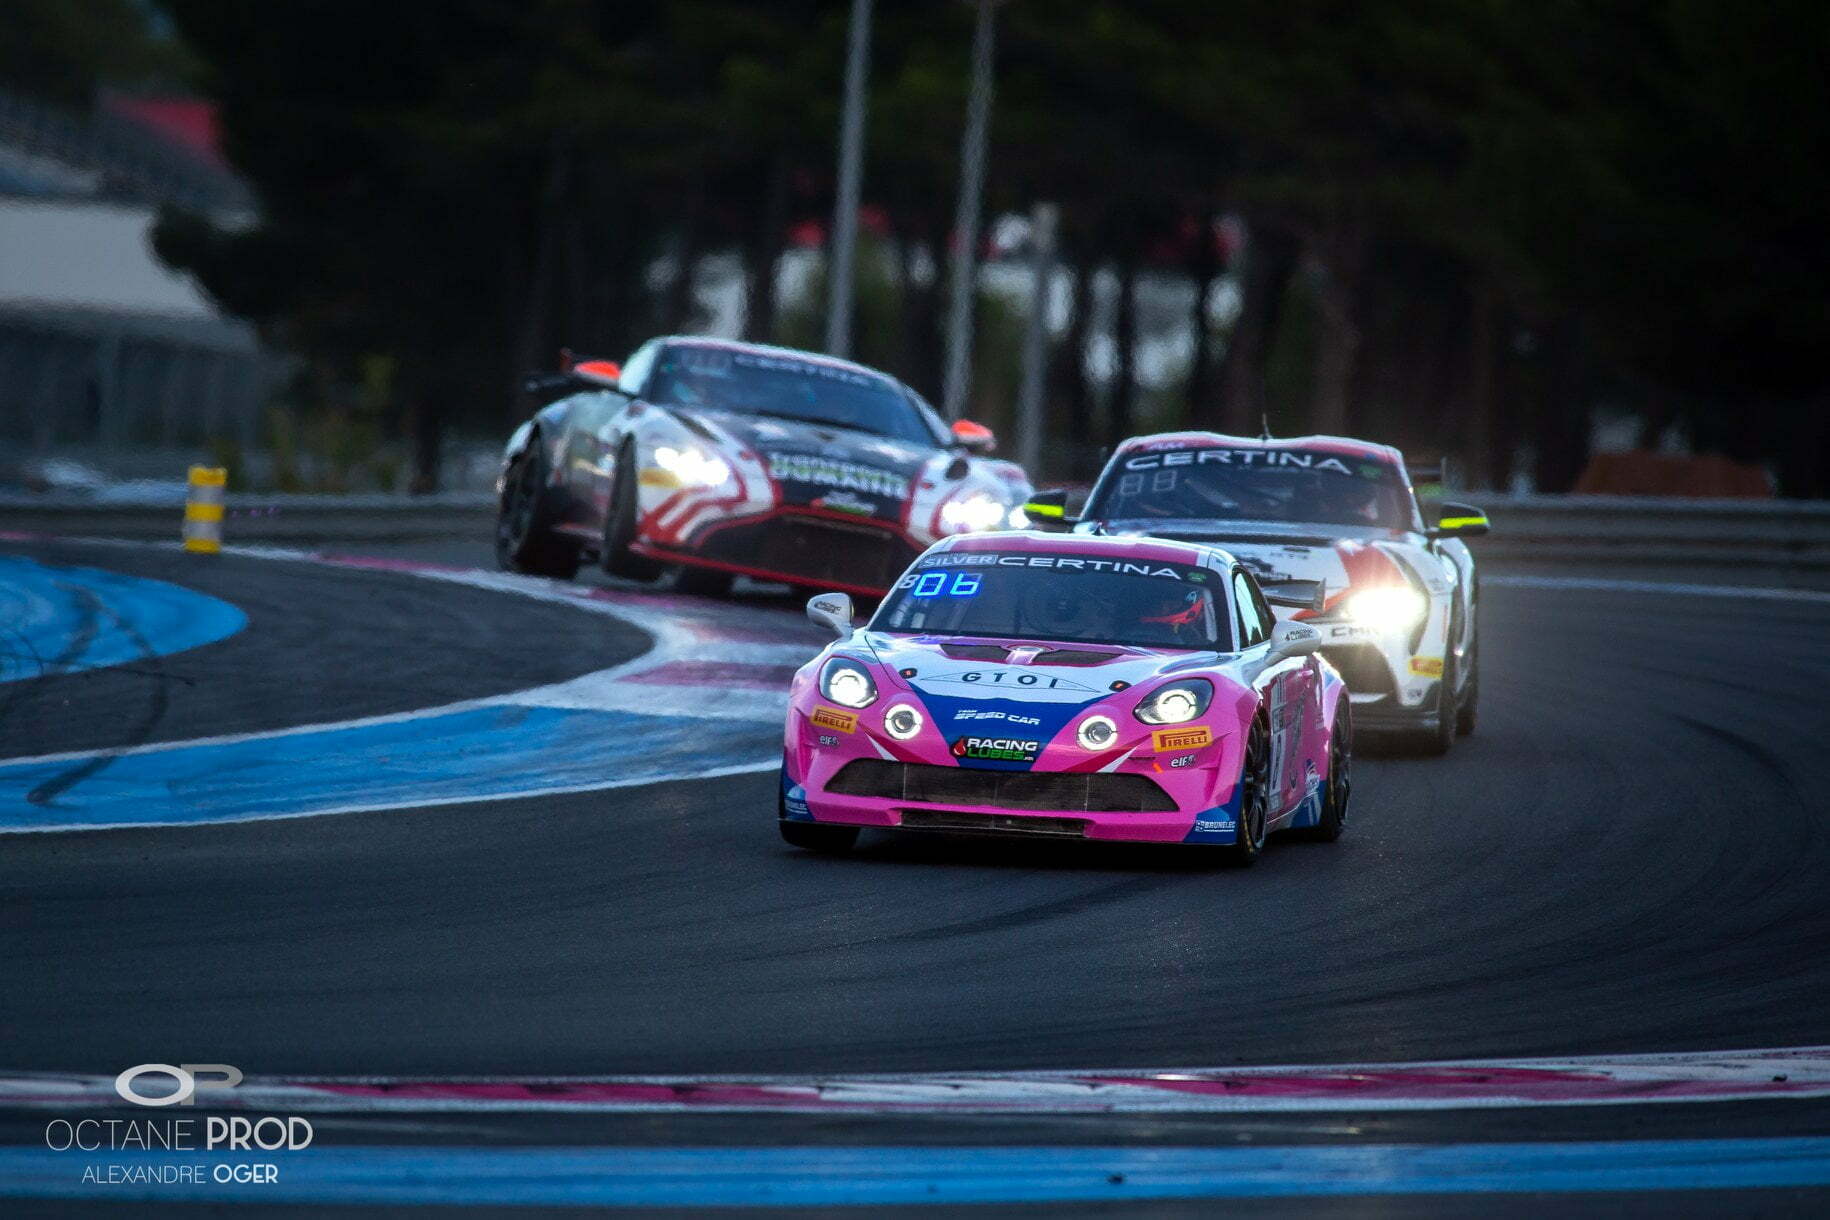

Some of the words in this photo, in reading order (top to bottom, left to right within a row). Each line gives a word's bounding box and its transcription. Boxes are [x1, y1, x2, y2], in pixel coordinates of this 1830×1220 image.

[1124, 449, 1353, 476] CERTINA
[923, 555, 993, 568] SILVER
[998, 555, 1182, 580] CERTINA
[812, 708, 853, 730] PIRELLI
[953, 711, 1007, 721] SPEED
[1007, 714, 1041, 726] CAR
[966, 737, 1039, 752] RACING
[1159, 730, 1207, 748] PIRELLI
[1170, 756, 1188, 768] elf
